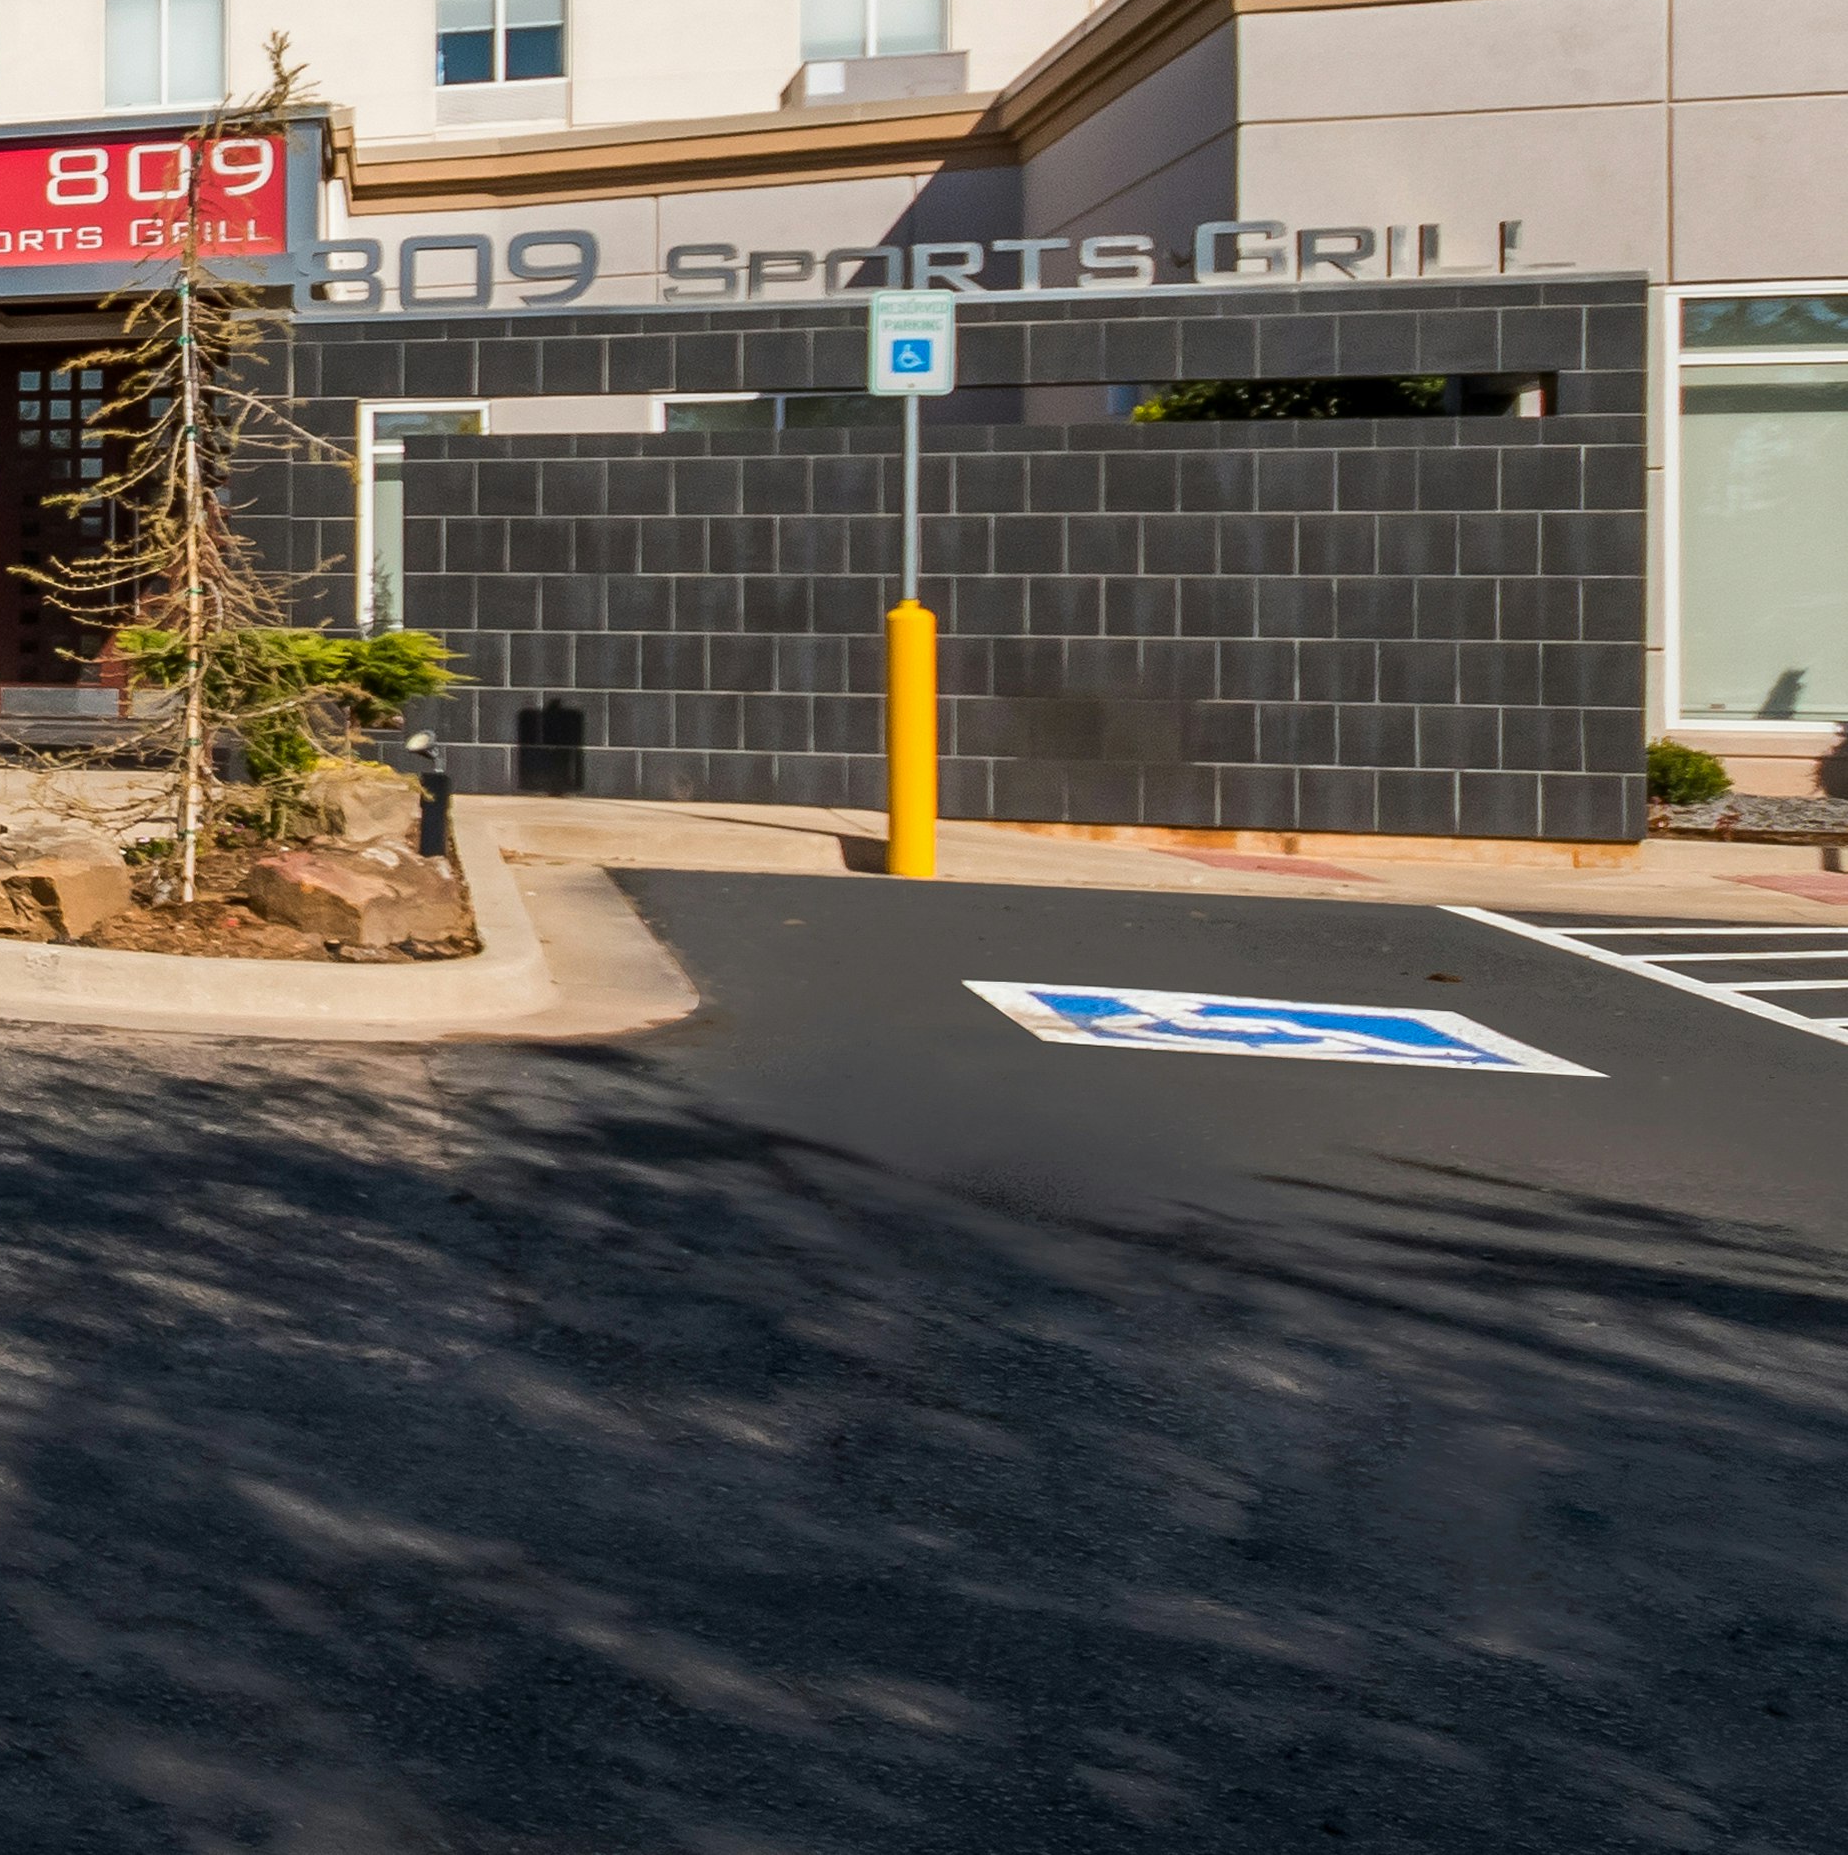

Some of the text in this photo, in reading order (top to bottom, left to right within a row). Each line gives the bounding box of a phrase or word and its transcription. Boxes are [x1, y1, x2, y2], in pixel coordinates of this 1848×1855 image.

[46, 138, 274, 206] 809
[293, 220, 1577, 312] 809 SPORTS GRILL
